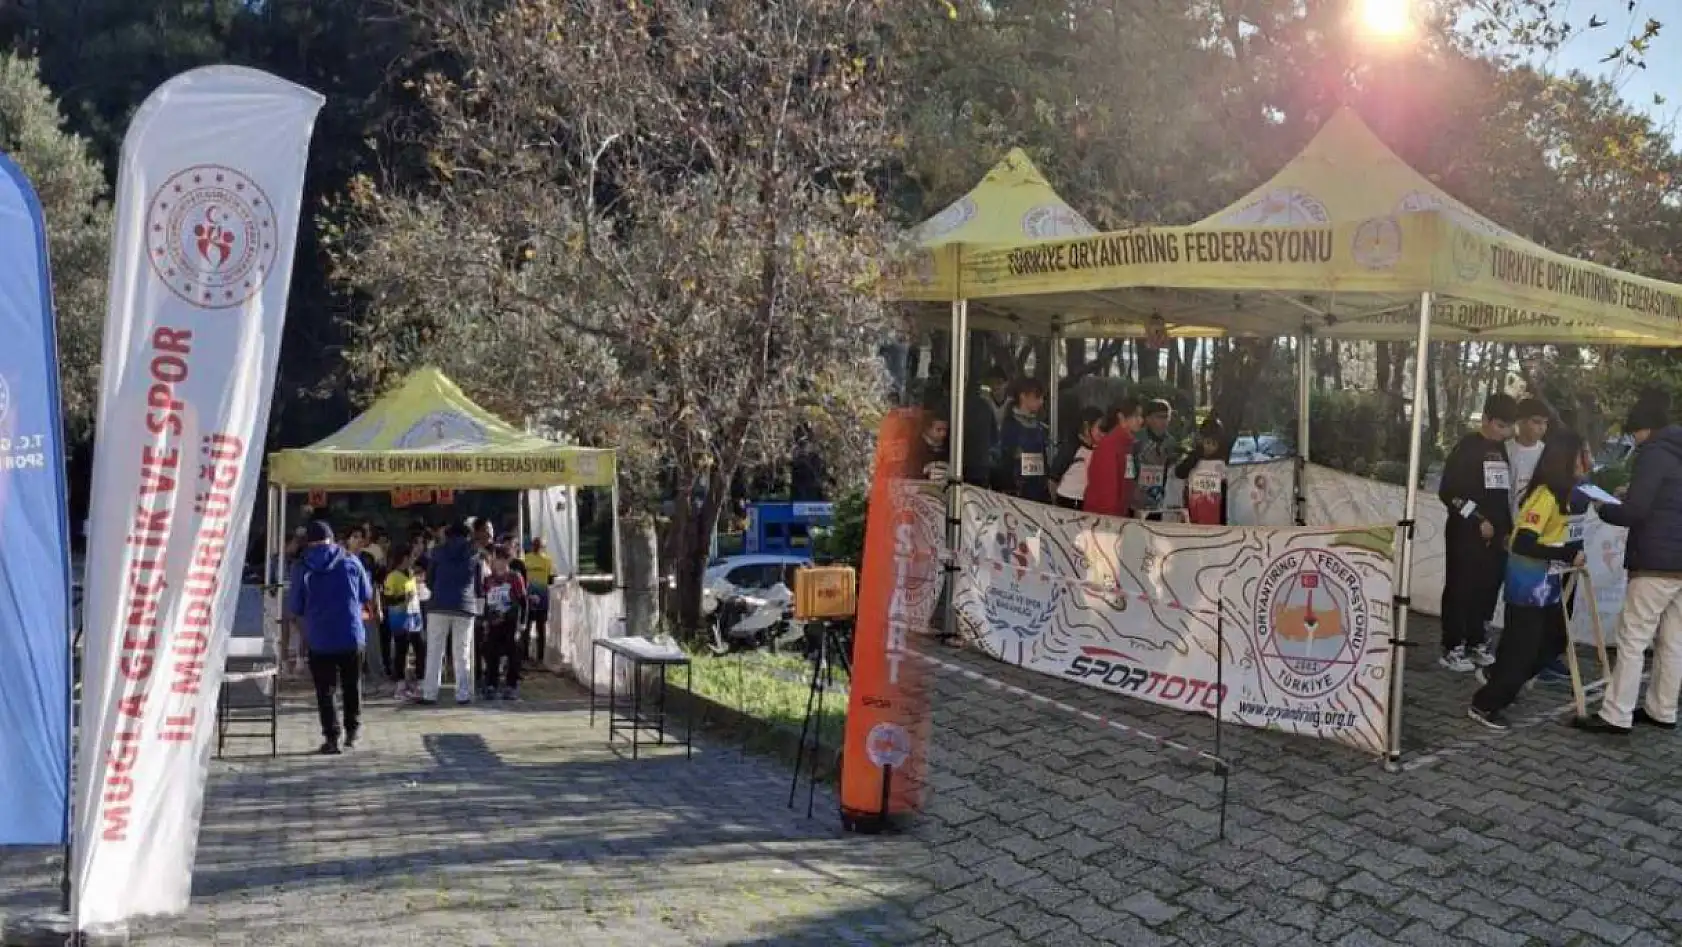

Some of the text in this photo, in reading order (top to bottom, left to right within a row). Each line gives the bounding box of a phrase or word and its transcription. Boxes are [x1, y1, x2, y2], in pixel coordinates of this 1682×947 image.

[1068, 227, 1179, 270] ORYANTİRİNG
[1184, 229, 1332, 263] FEDERASYONU
[475, 453, 566, 473] FEDERASYONU
[103, 326, 192, 842] MUĞLA GENÇLİK VE SPOR
[1318, 553, 1366, 650] FEDERASYONU
[156, 706, 197, 742] İL
